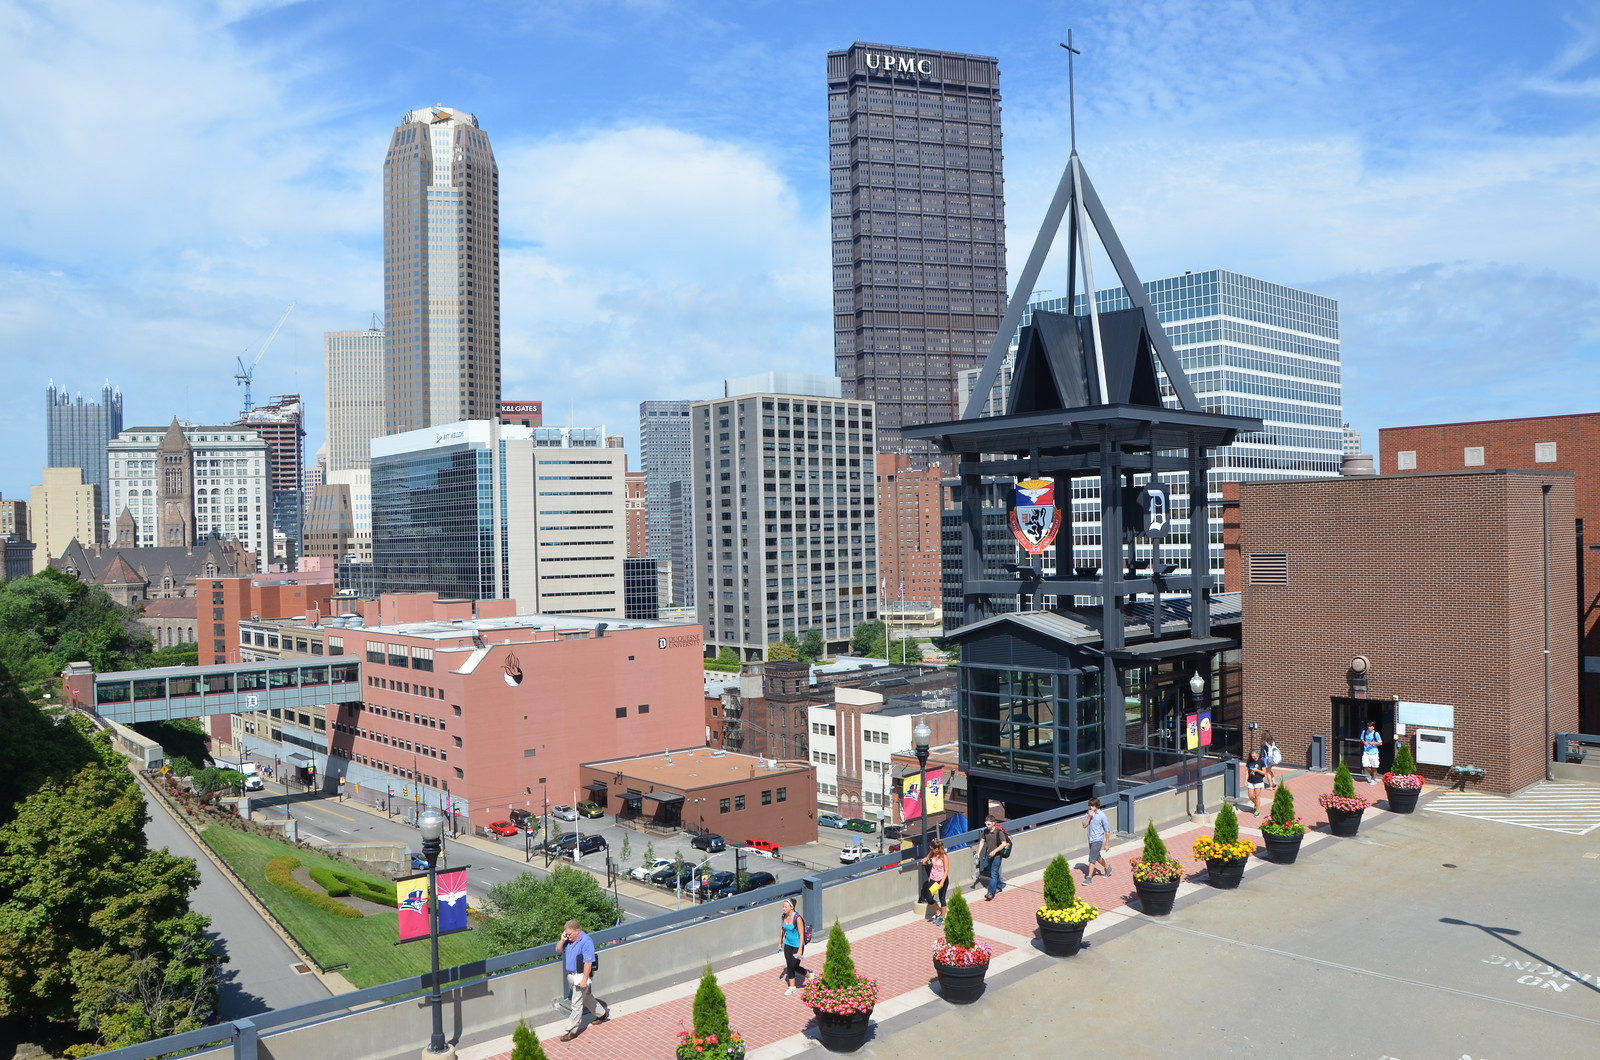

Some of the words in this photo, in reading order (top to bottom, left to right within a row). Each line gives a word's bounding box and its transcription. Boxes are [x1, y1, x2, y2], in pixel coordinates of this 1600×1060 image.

[866, 53, 931, 74] UPMC
[669, 634, 700, 642] DUQUESNE
[669, 640, 700, 648] UNIVERSITY
[1517, 975, 1571, 992] NO
